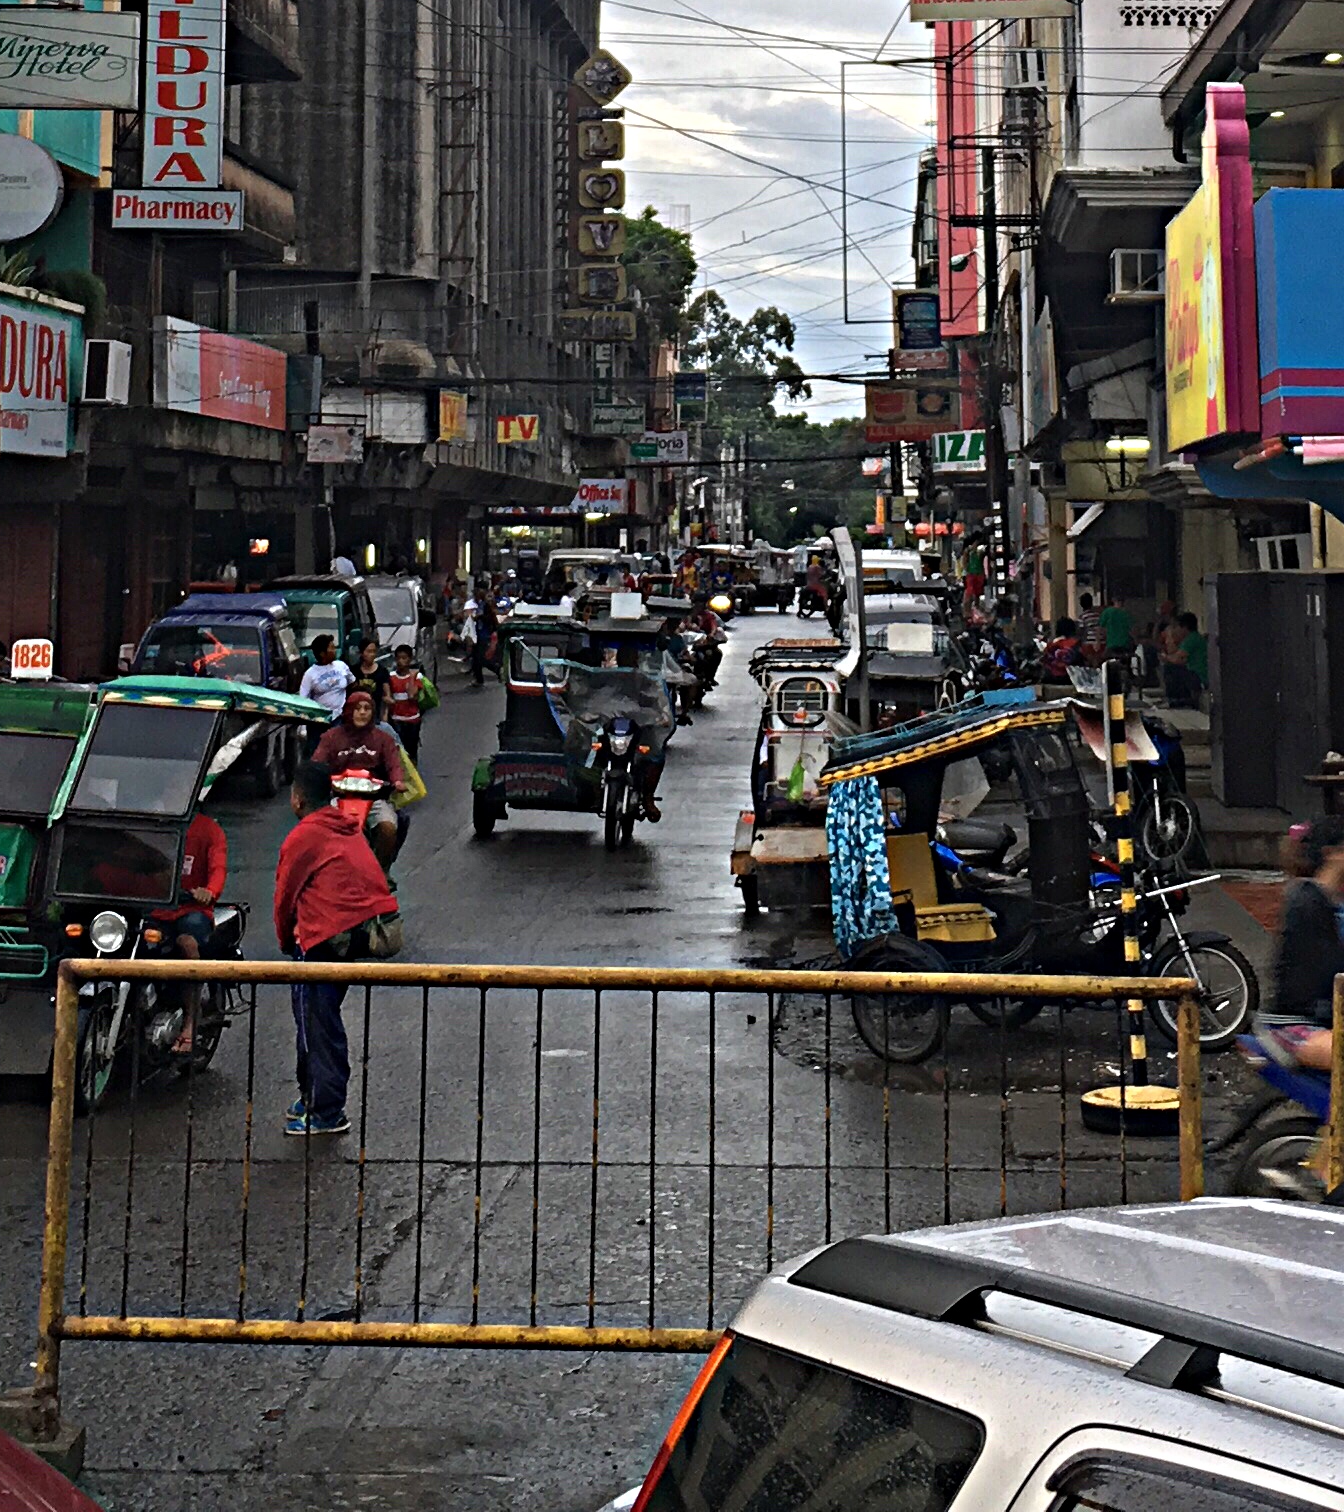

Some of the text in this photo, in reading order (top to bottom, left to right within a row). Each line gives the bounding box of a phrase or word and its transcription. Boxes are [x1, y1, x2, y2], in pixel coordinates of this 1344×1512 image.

[115, 194, 237, 225] Pharmacy
[498, 415, 537, 439] TV
[579, 483, 609, 502] Office
[14, 644, 51, 668] 1826
